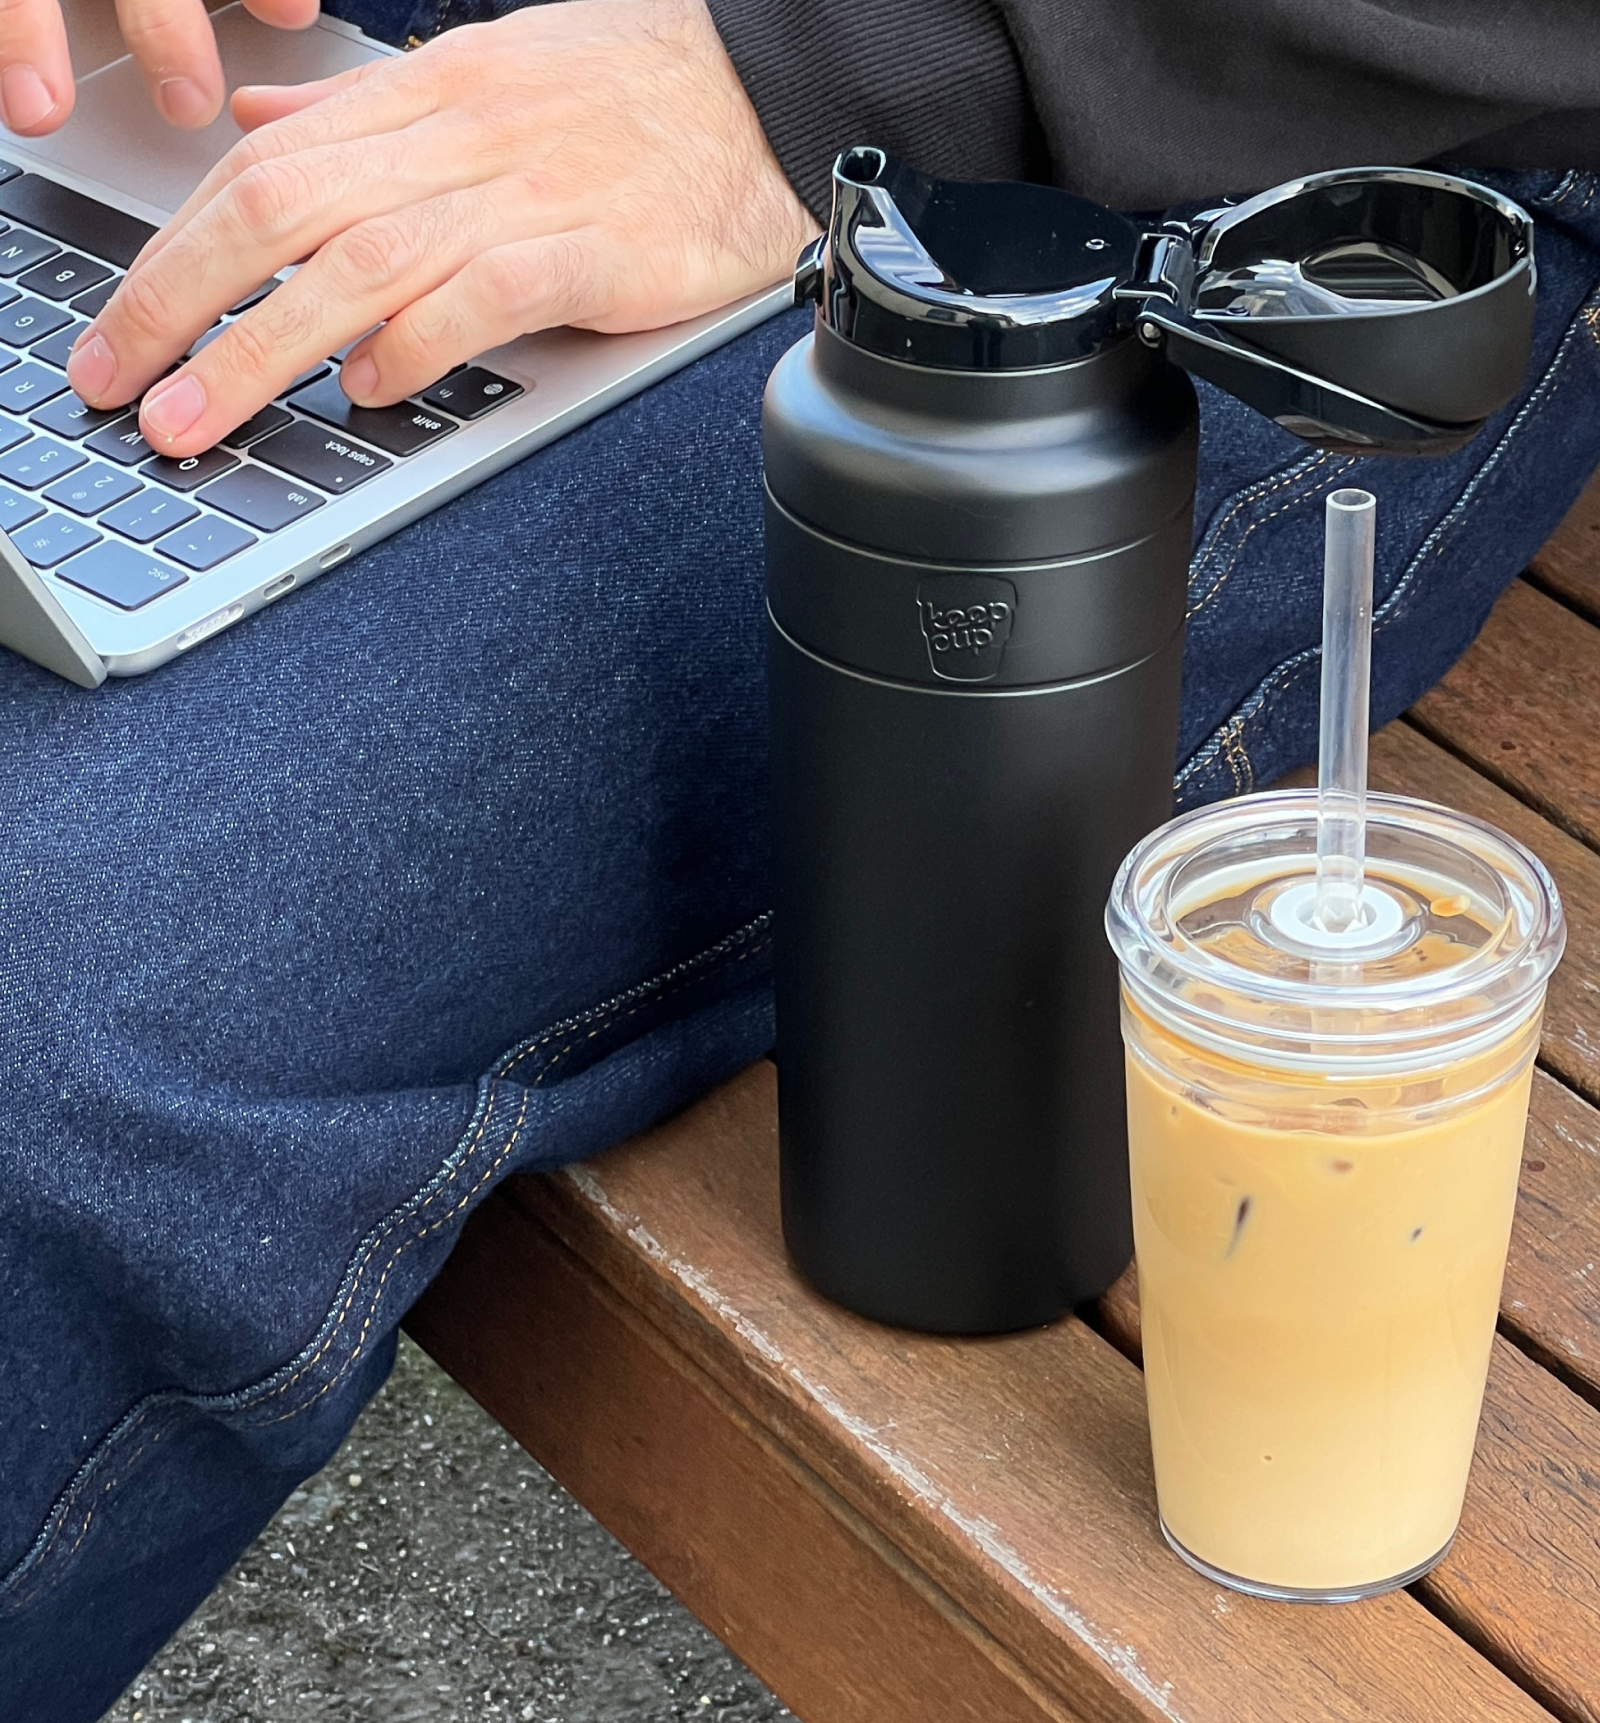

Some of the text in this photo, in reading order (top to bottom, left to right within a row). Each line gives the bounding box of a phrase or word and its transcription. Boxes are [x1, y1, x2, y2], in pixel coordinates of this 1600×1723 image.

[2, 246, 24, 259] N
[55, 269, 76, 283] B
[14, 315, 35, 328] G
[14, 380, 35, 394] R
[438, 388, 454, 399] fn
[67, 406, 89, 419] E
[411, 414, 442, 430] shift
[119, 431, 144, 446] W
[39, 450, 59, 463] 3
[324, 440, 376, 466] caps lock
[178, 456, 199, 470] Q
[94, 475, 114, 488] 2
[286, 491, 308, 506] tab
[150, 502, 167, 514] 1
[147, 567, 170, 581] esc
[926, 601, 1010, 630] keep
[930, 627, 994, 656] cup
